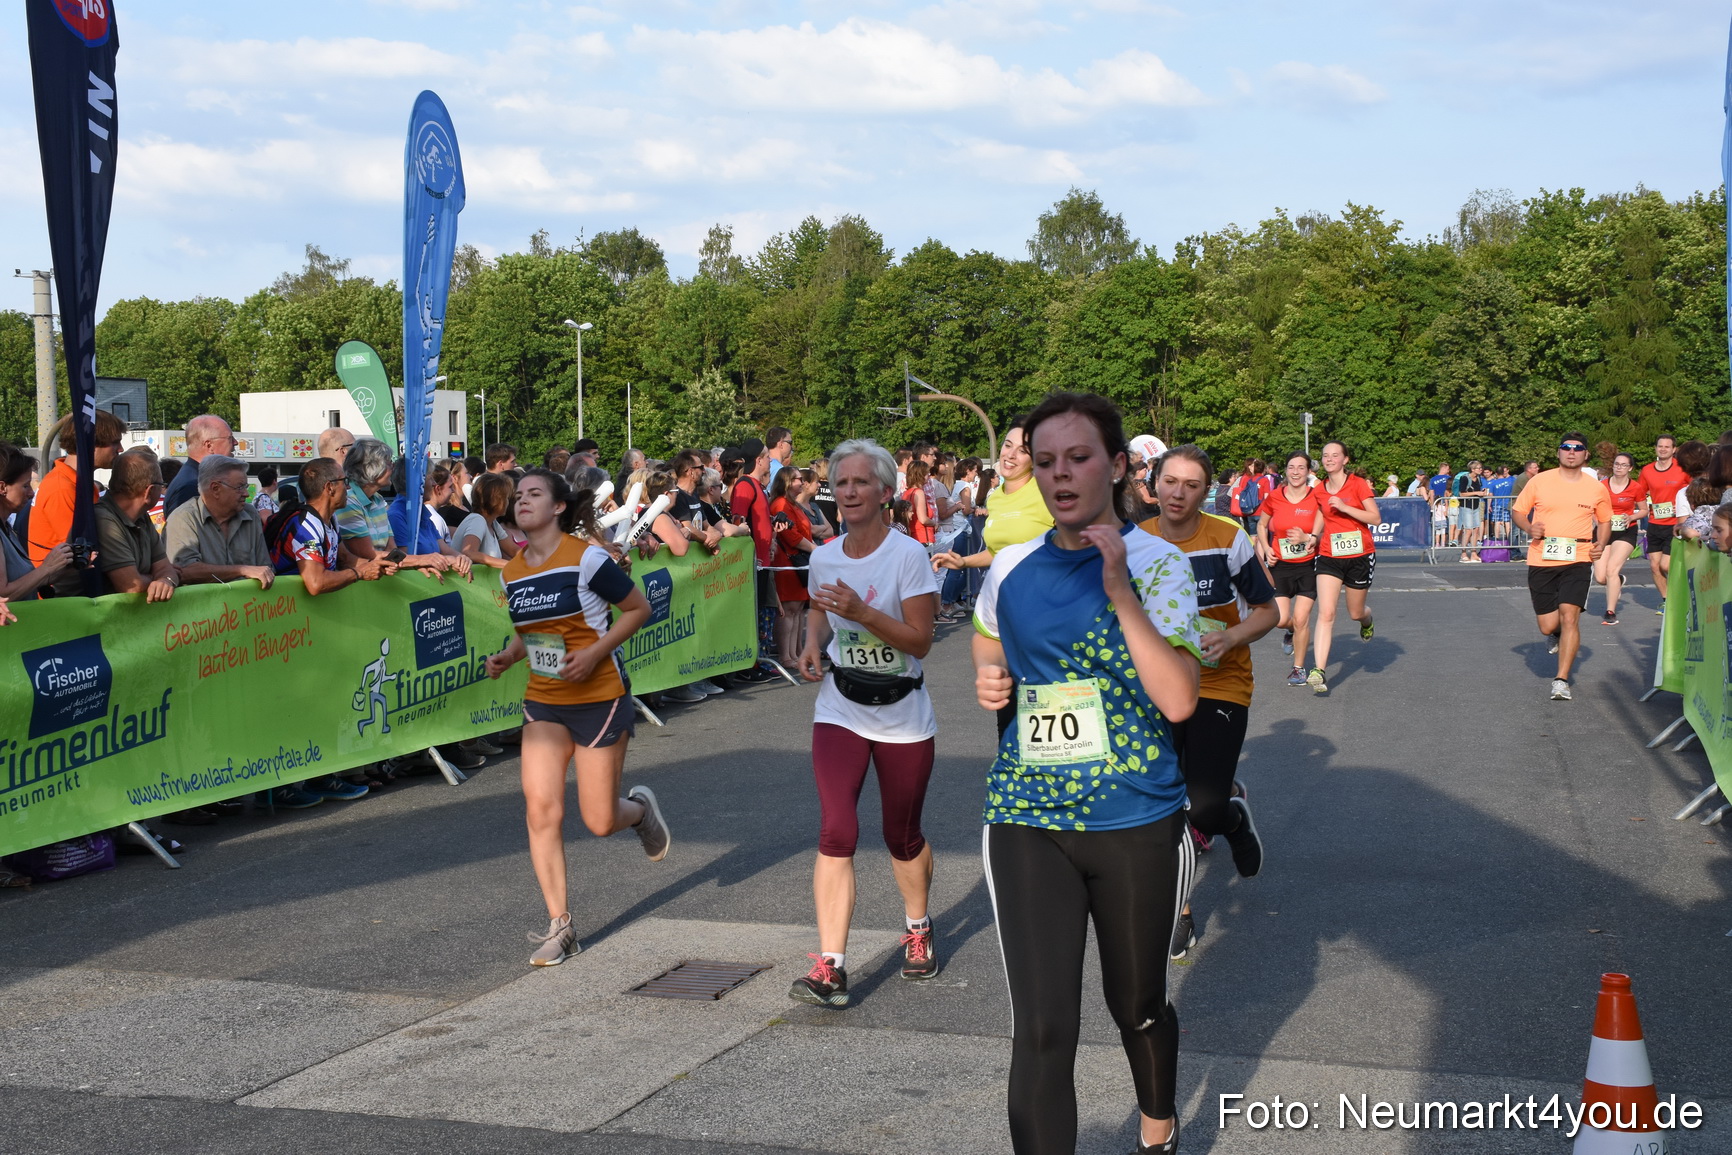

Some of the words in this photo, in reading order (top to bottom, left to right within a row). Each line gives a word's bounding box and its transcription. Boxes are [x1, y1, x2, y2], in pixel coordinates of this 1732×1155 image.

[1655, 507, 1671, 515] 1029
[1334, 539, 1359, 550] 1033
[1546, 544, 1572, 555] 228
[513, 592, 561, 609] Fischer
[650, 586, 670, 600] Fischer
[518, 602, 557, 614] AUTOMOBILE
[165, 601, 241, 652] Gesunde
[244, 595, 297, 627] Firmen
[423, 615, 457, 633] Fischer
[427, 626, 455, 639] AUTOMOBILE
[629, 603, 695, 659] firmenlauf
[199, 640, 249, 680] laufen
[254, 616, 313, 663] länger!
[846, 646, 895, 666] 1316
[535, 650, 558, 668] 9138
[630, 651, 661, 673] neumarkt
[47, 665, 99, 690] Fischer
[54, 680, 98, 699] AUTOMOBILE
[397, 696, 447, 726] neumarkt
[1028, 712, 1080, 743] 270
[1063, 740, 1094, 750] Carolin
[126, 740, 323, 806] www.firmenlauf-oberpfalz.de
